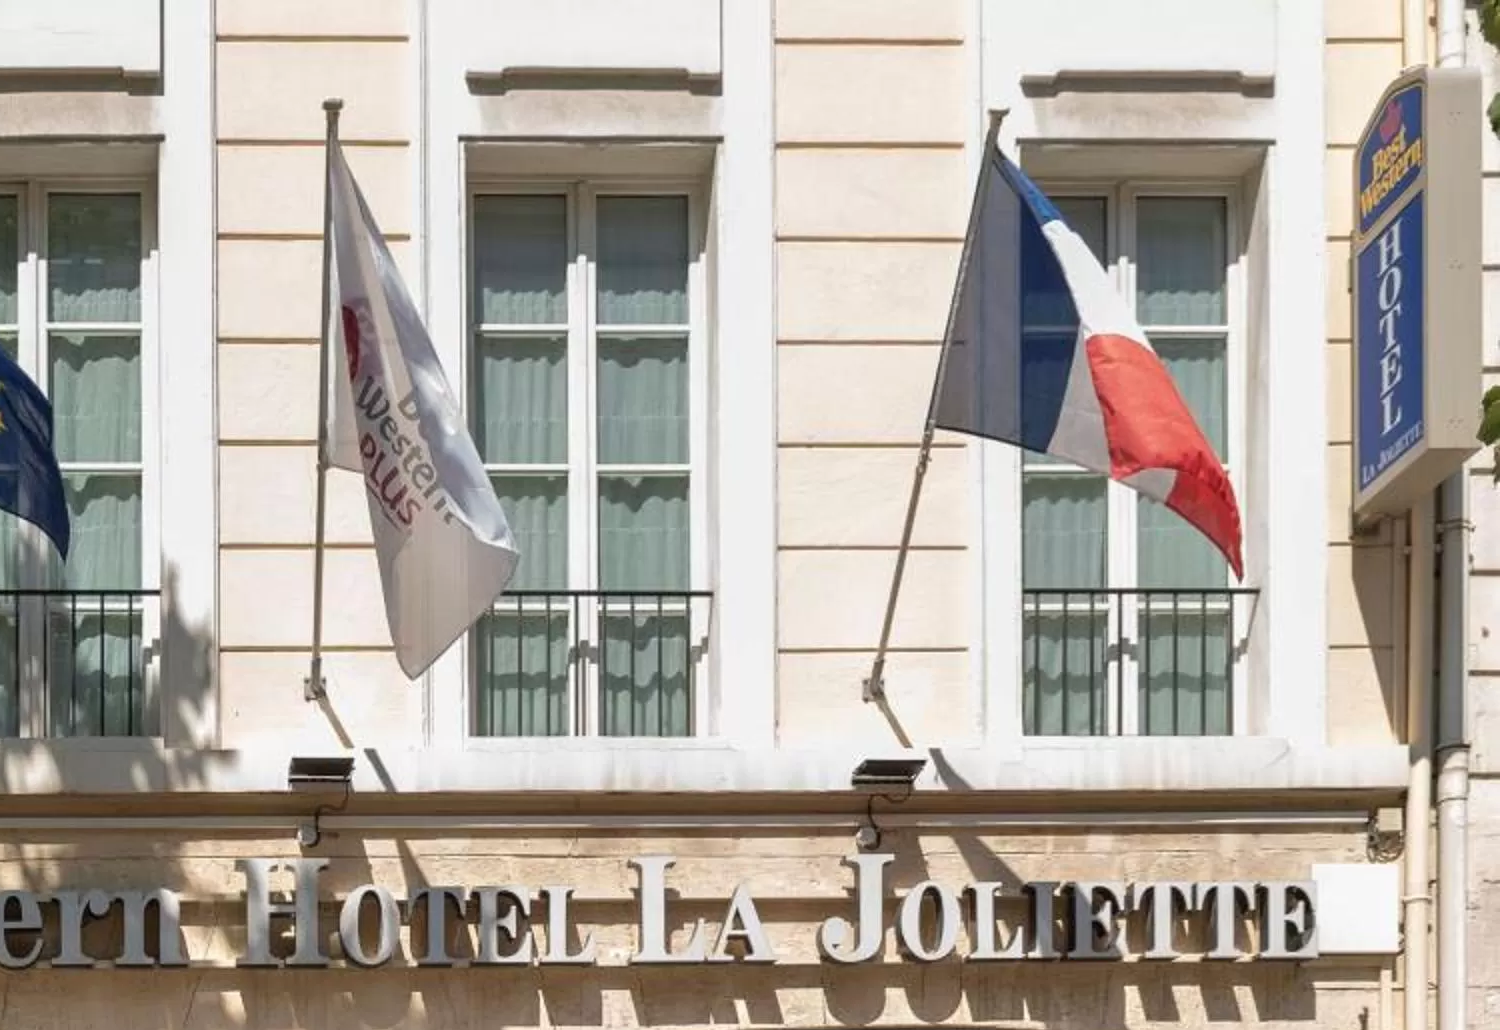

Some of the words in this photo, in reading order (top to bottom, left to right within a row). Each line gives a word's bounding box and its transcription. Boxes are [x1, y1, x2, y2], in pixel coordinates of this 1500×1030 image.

[1361, 136, 1423, 219] Western
[1372, 123, 1407, 183] Best
[1378, 217, 1403, 437] HOTEL
[234, 855, 596, 968] HOTEL
[821, 852, 1320, 965] JOLIETTE
